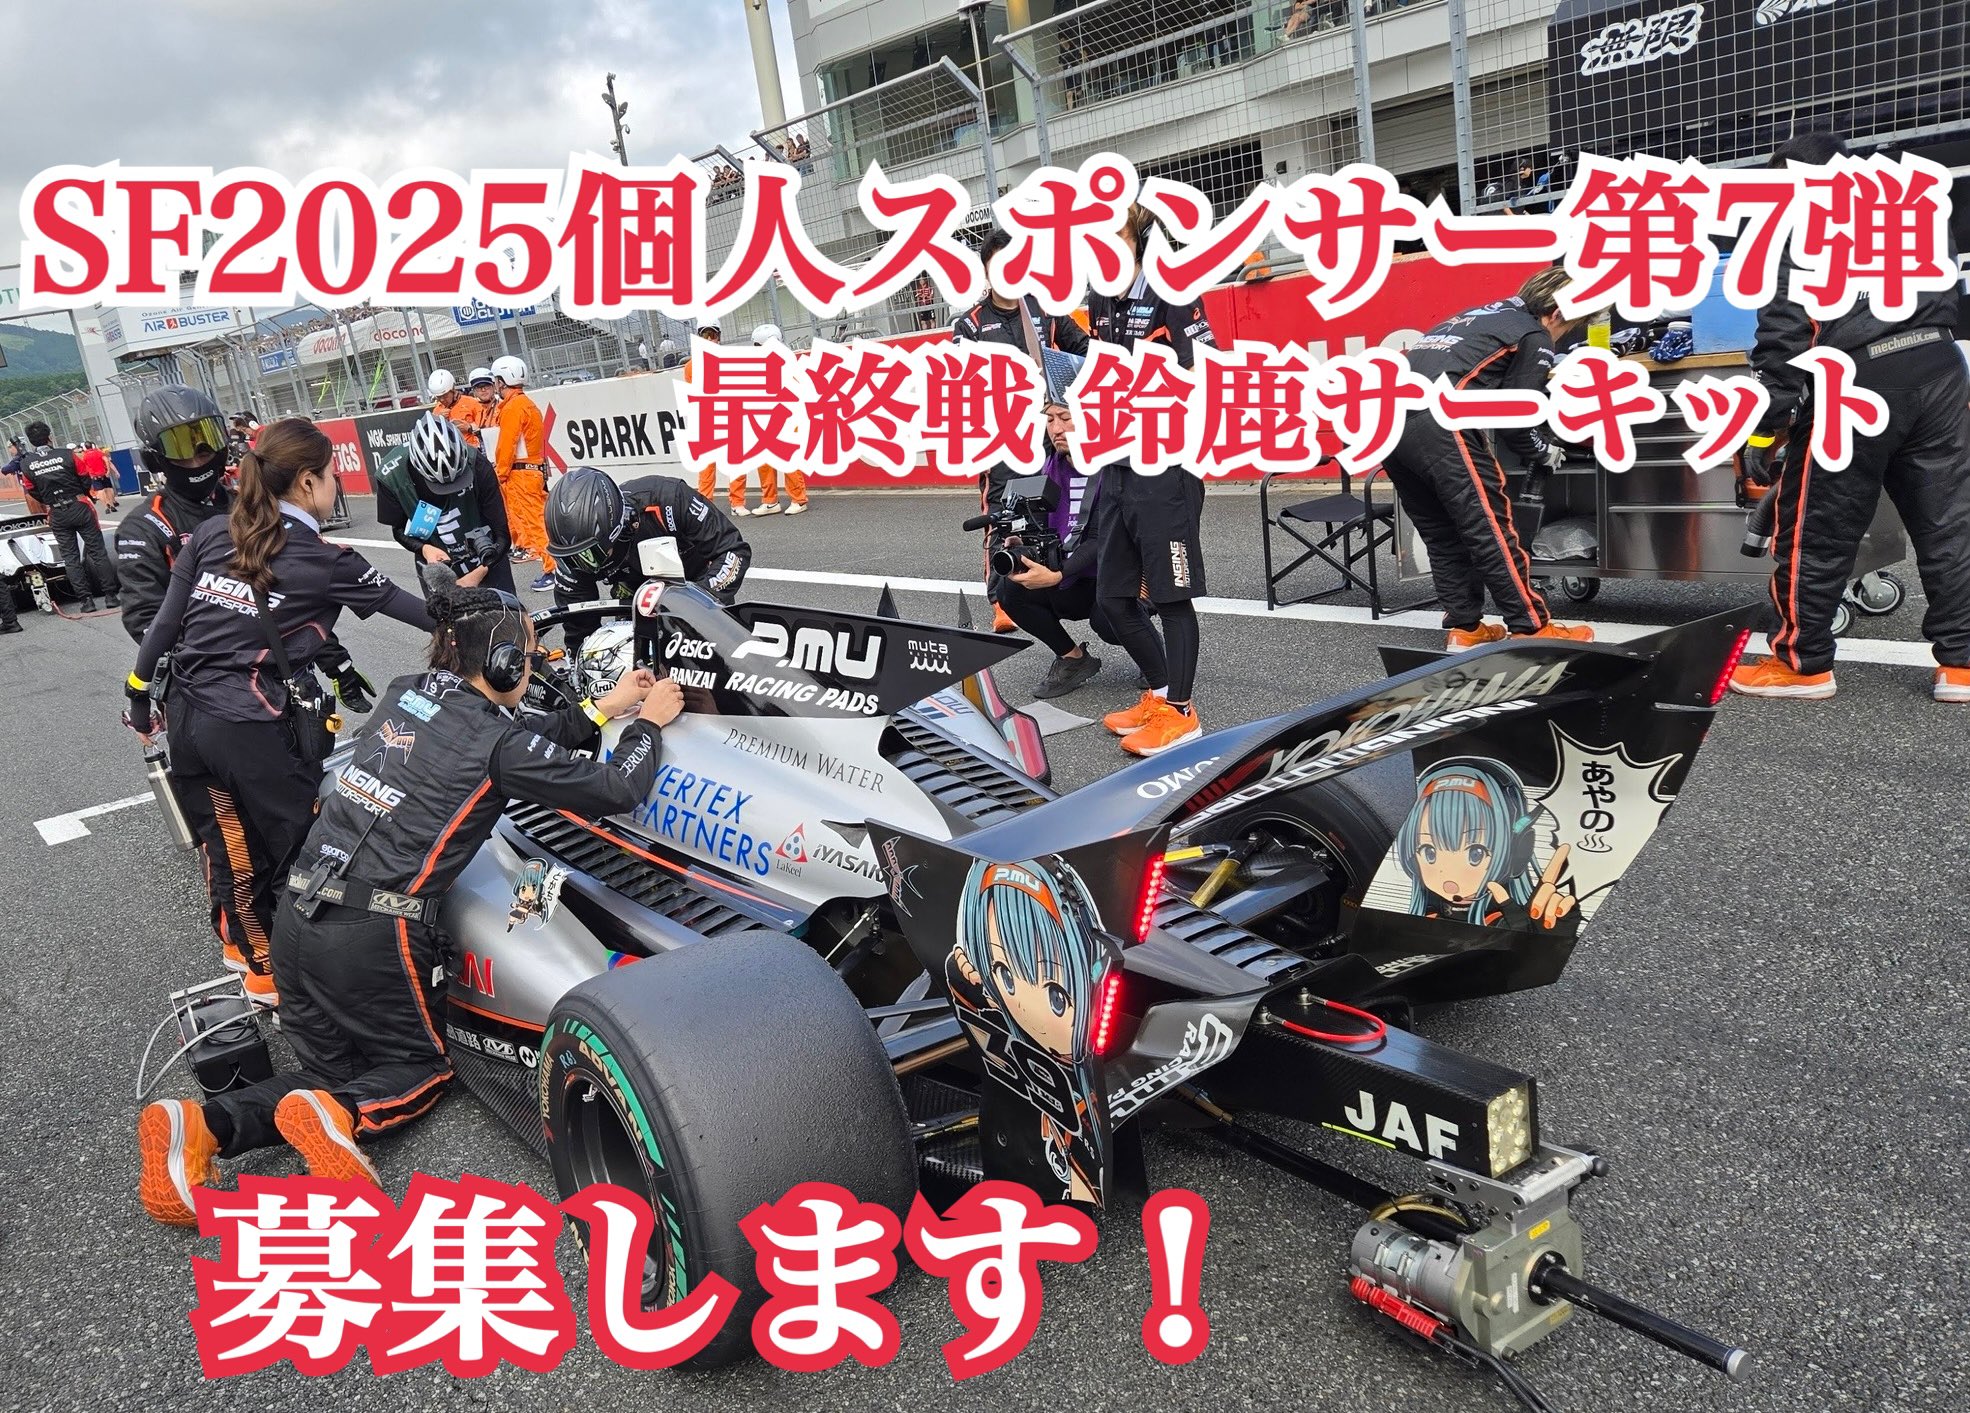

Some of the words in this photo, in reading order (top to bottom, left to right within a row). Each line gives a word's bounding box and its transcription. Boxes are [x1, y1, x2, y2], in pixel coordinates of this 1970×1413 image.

[144, 321, 166, 332] AIR
[179, 310, 229, 328] BUSTER
[1870, 331, 1940, 356] mechanix.com
[366, 428, 386, 448] NGK
[566, 412, 656, 460] SPARK
[1170, 541, 1184, 588] INGING
[679, 638, 717, 660] asics
[908, 640, 948, 654] muta
[592, 683, 613, 696] Arai
[669, 667, 717, 690] BANZAI
[725, 672, 818, 702] RACING
[816, 688, 879, 715] PADS
[1261, 661, 1569, 780] YOKOHAMA
[723, 728, 808, 770] PREMIUM
[818, 752, 884, 793] WATER
[1580, 760, 1617, 833] あやの
[321, 843, 350, 863] sparco
[541, 1051, 555, 1120] YOKOHAMA
[578, 1040, 643, 1142] ADVAN
[1344, 1089, 1459, 1160] JAF
